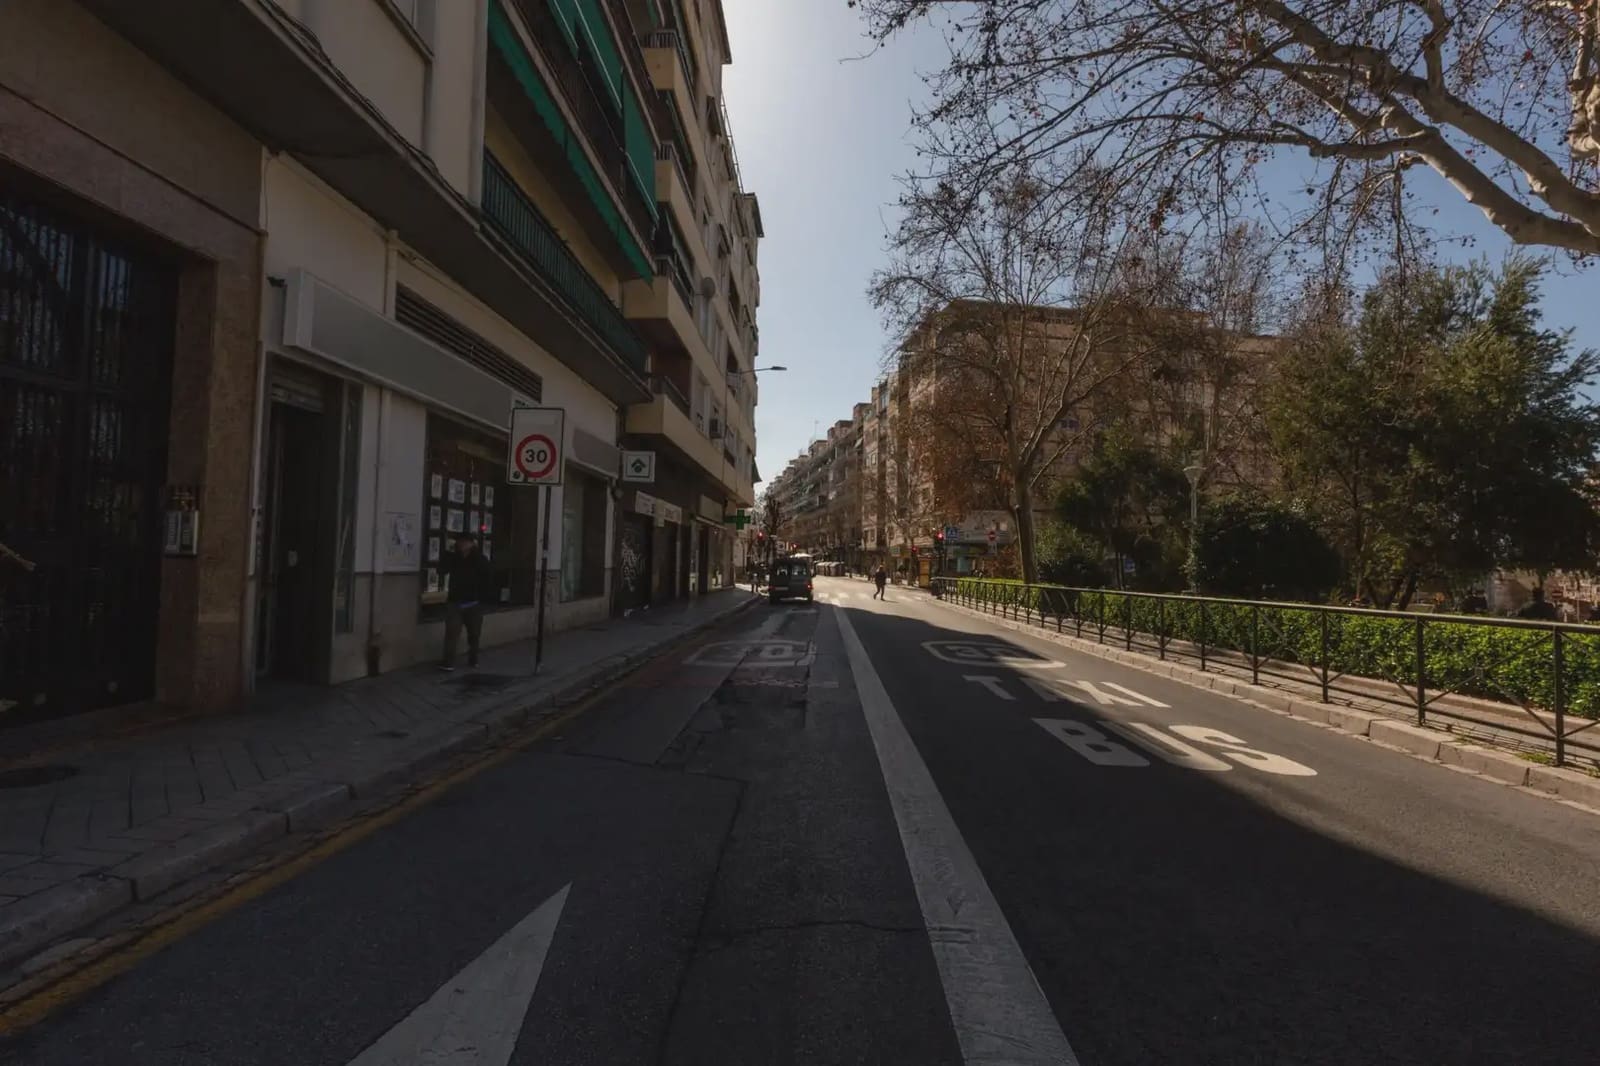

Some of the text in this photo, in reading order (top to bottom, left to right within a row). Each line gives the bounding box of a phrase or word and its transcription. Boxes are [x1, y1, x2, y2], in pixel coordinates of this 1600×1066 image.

[525, 449, 547, 463] 30
[962, 675, 1172, 708] TAXI
[1032, 718, 1318, 776] BUS
